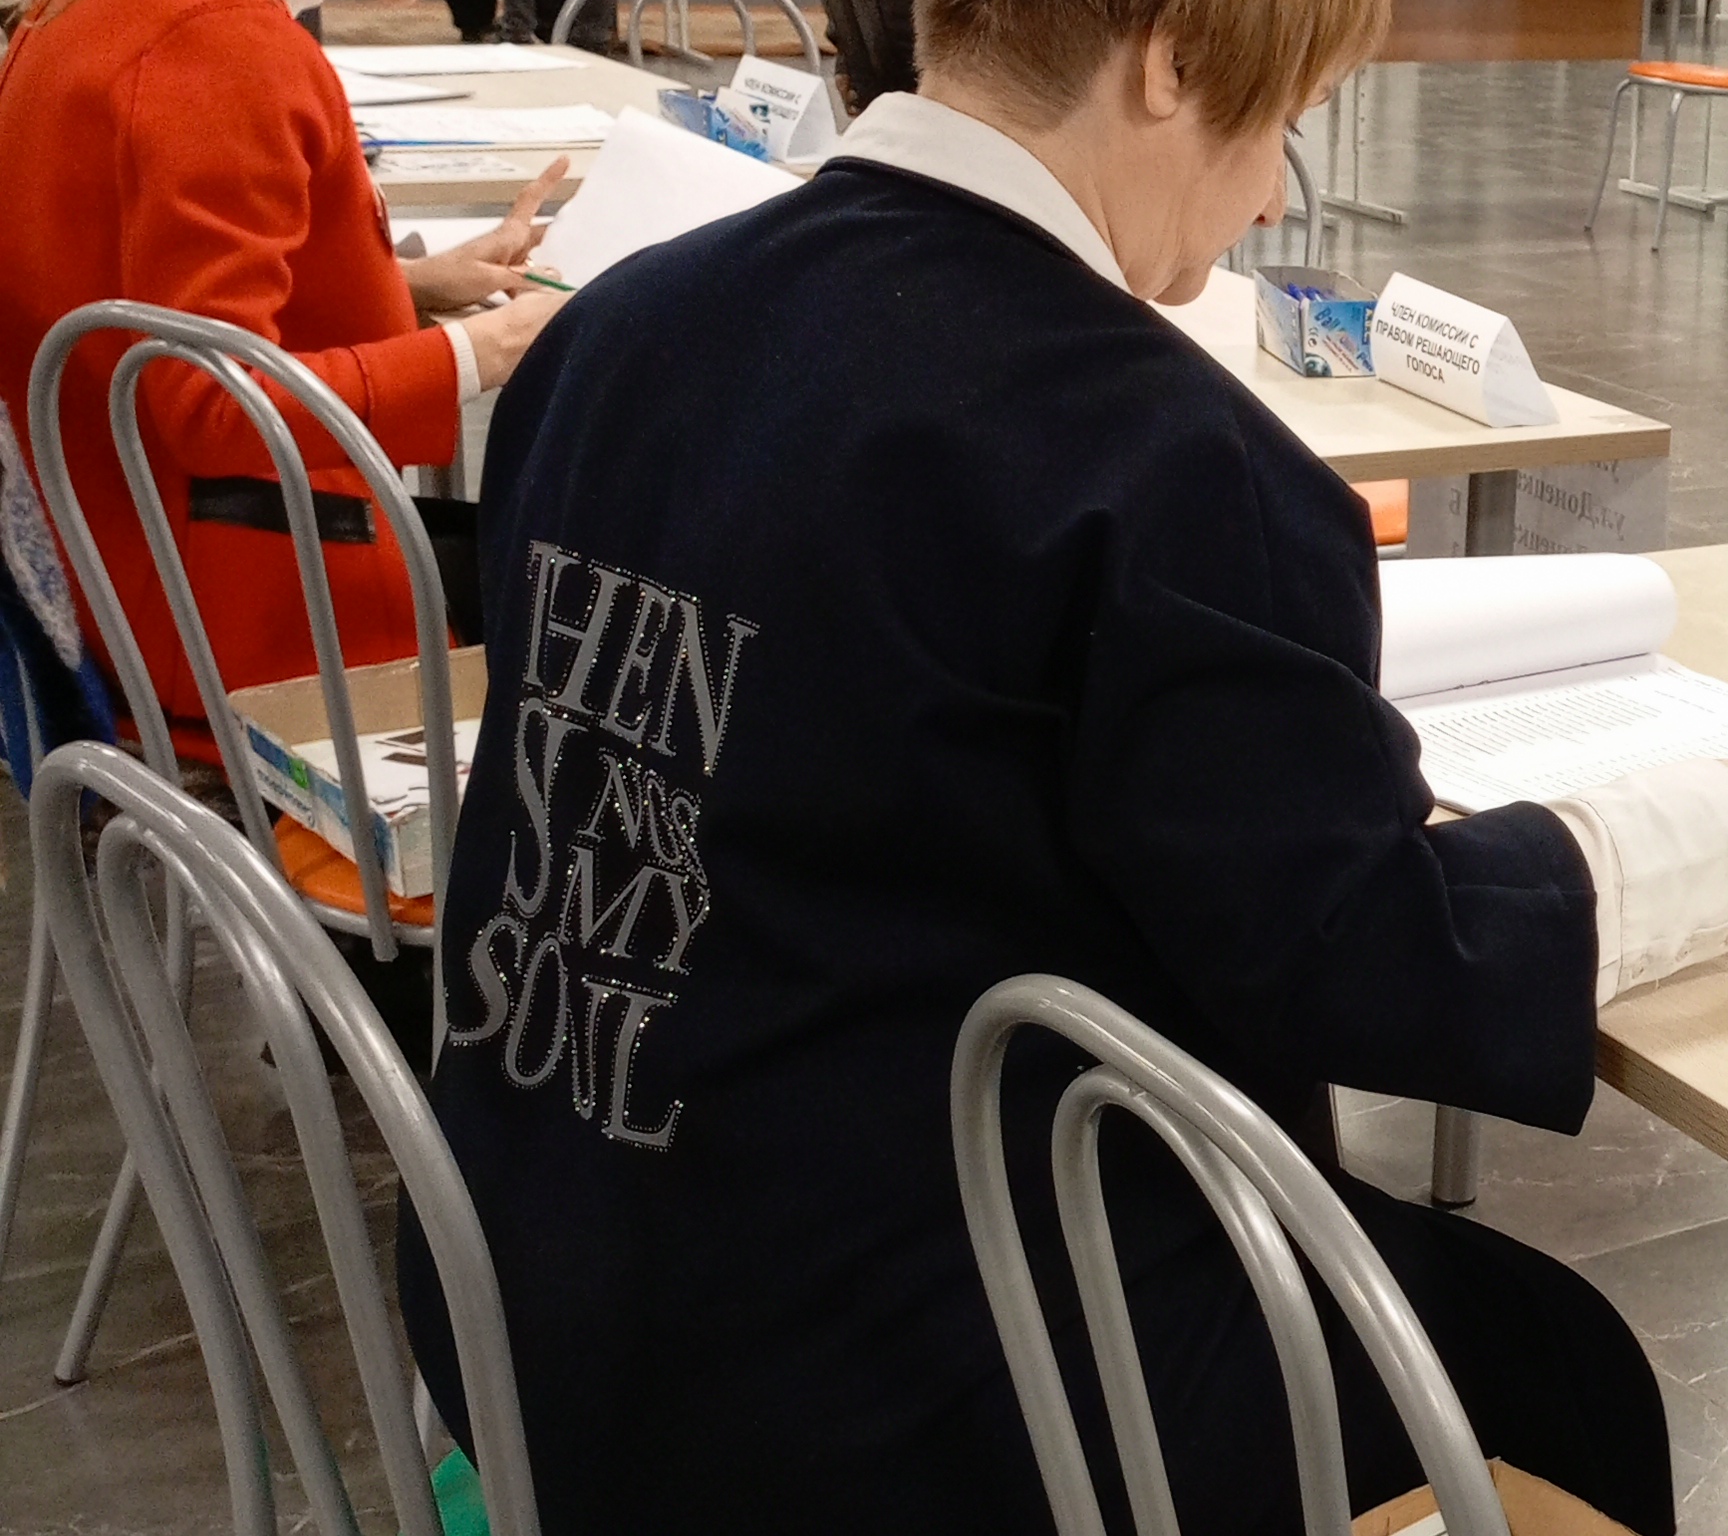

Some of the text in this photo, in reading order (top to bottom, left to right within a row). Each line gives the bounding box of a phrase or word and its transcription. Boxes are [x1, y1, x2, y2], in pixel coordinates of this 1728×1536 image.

[1376, 319, 1415, 347] ПРАВОМ
[1416, 336, 1480, 375] РЕШАЮЩЕГО
[1391, 301, 1479, 348] ЧЛЕН КОМИССИИ С
[1407, 354, 1445, 384] ГОЛОСА
